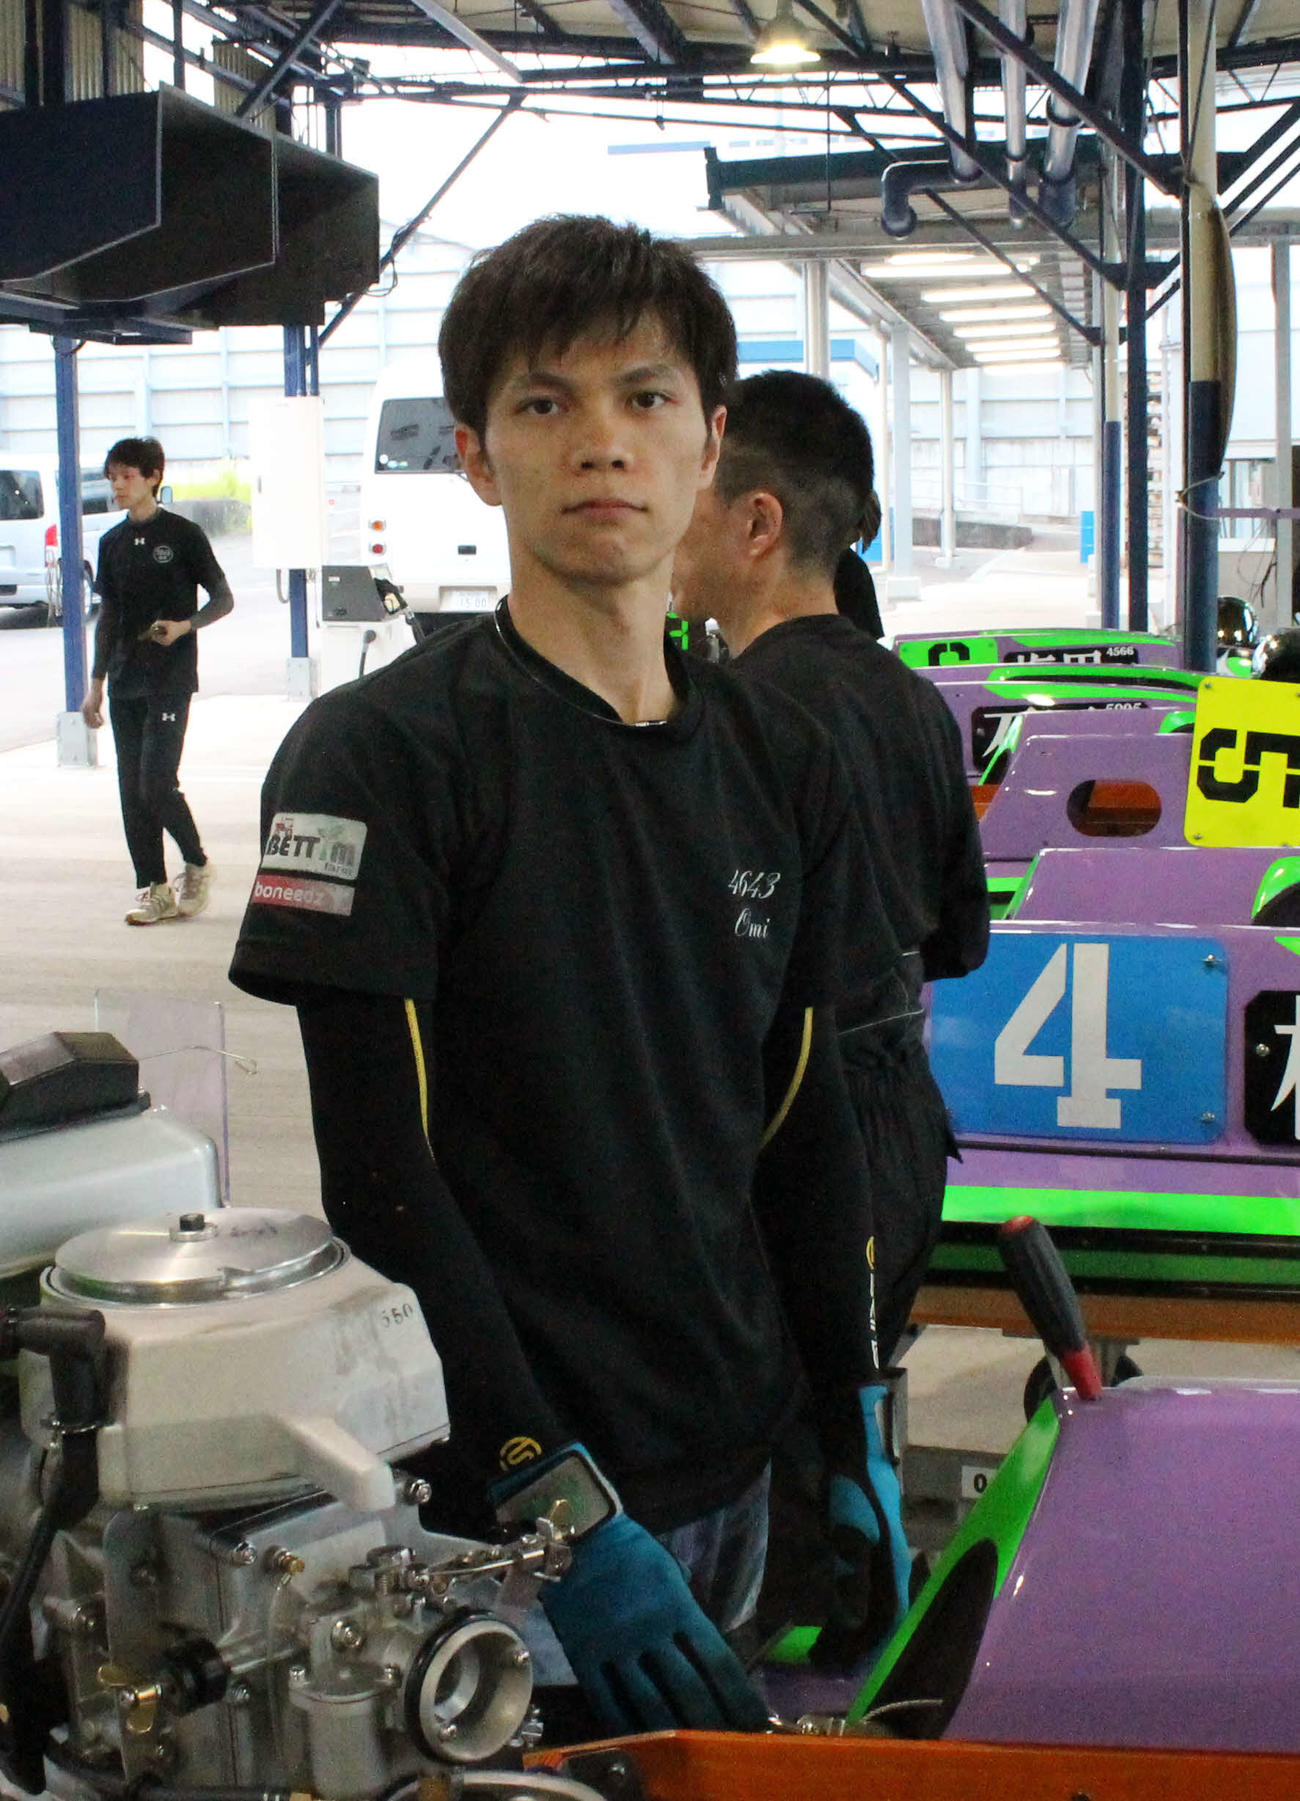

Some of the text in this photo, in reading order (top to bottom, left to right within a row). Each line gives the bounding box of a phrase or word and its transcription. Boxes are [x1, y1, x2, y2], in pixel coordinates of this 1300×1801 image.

[1105, 646, 1135, 657] 4566
[728, 869, 781, 899] 4643
[734, 908, 770, 938] Omi
[994, 943, 1142, 1129] 4
